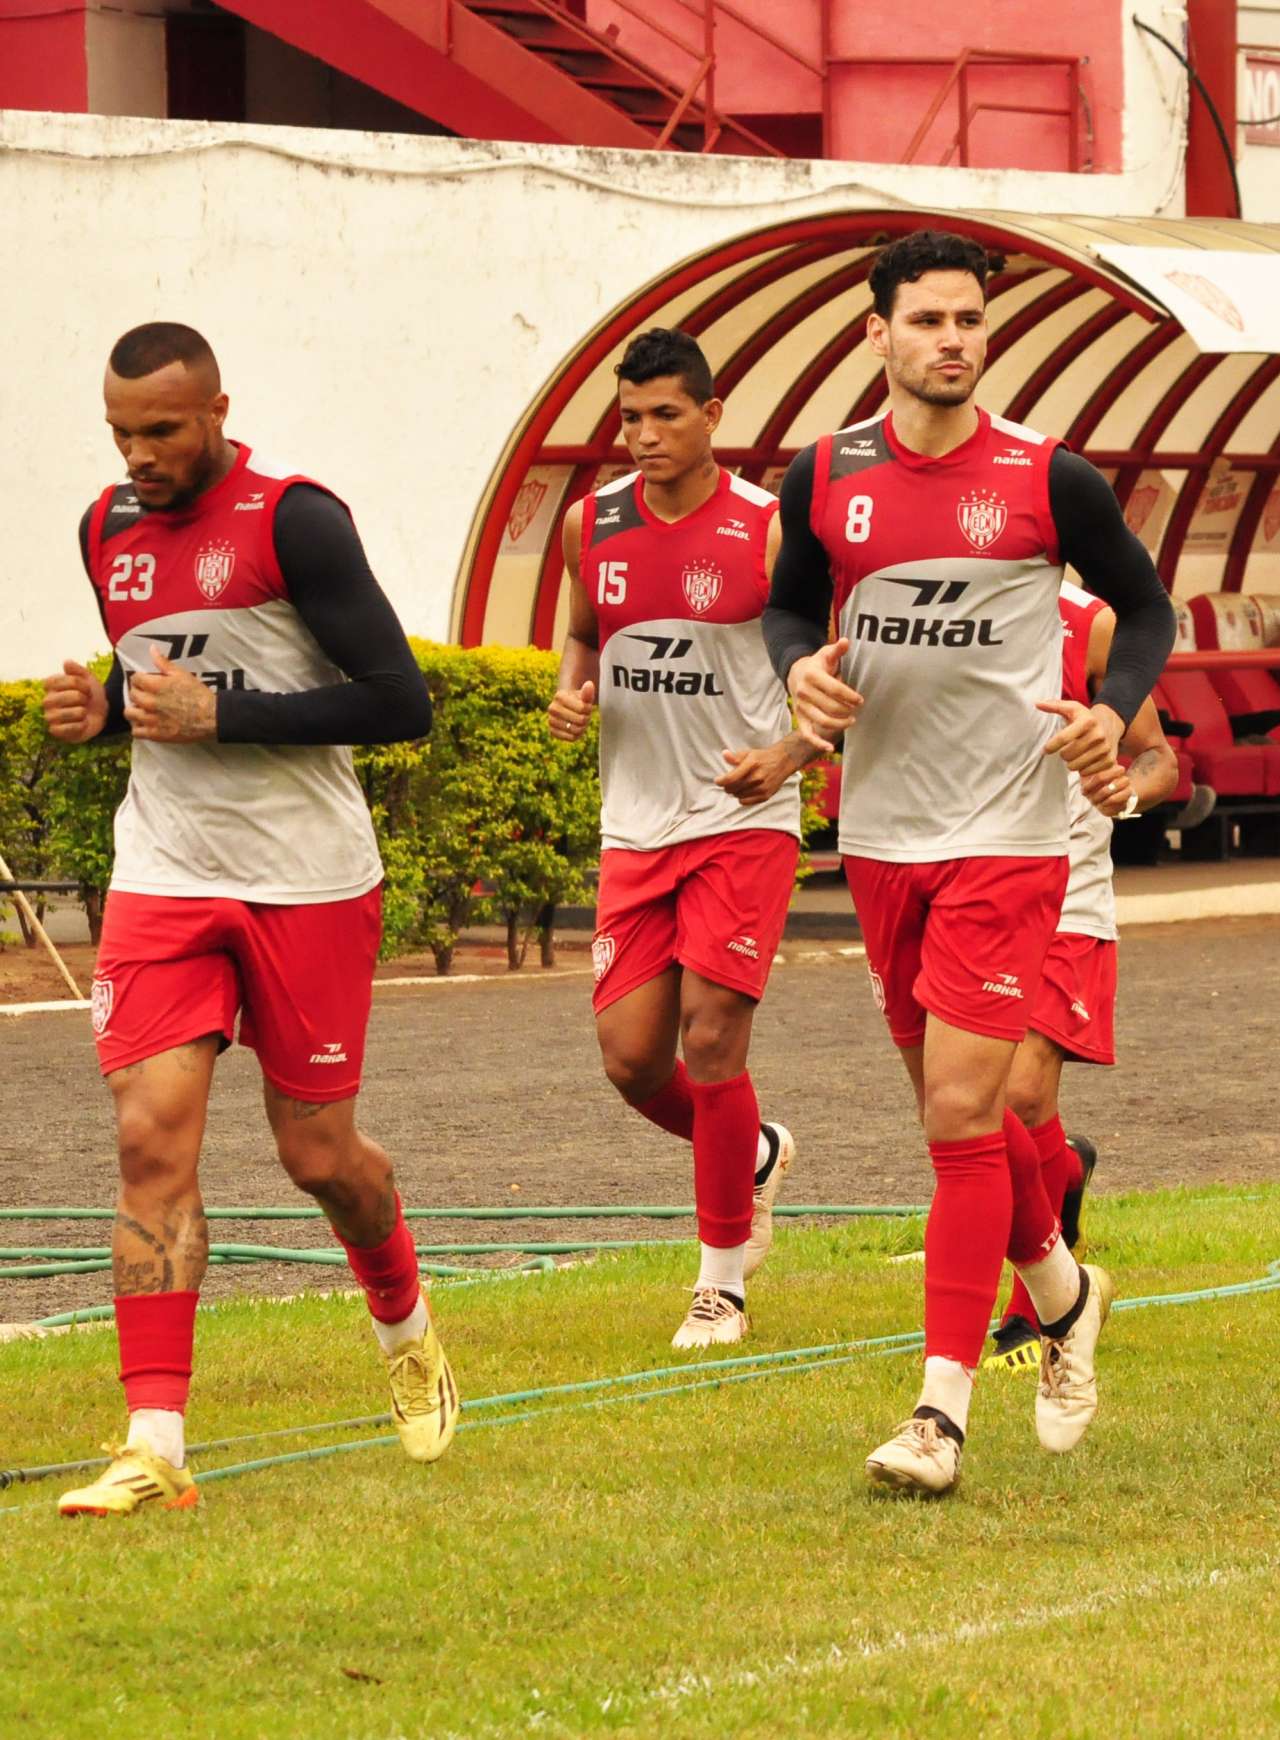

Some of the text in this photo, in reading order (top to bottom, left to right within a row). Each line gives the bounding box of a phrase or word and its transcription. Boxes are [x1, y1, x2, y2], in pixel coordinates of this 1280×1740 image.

[845, 495, 874, 543] 8
[108, 553, 156, 601] 23
[597, 561, 629, 605] 15
[855, 613, 1004, 648] nakal
[612, 665, 724, 696] nakal
